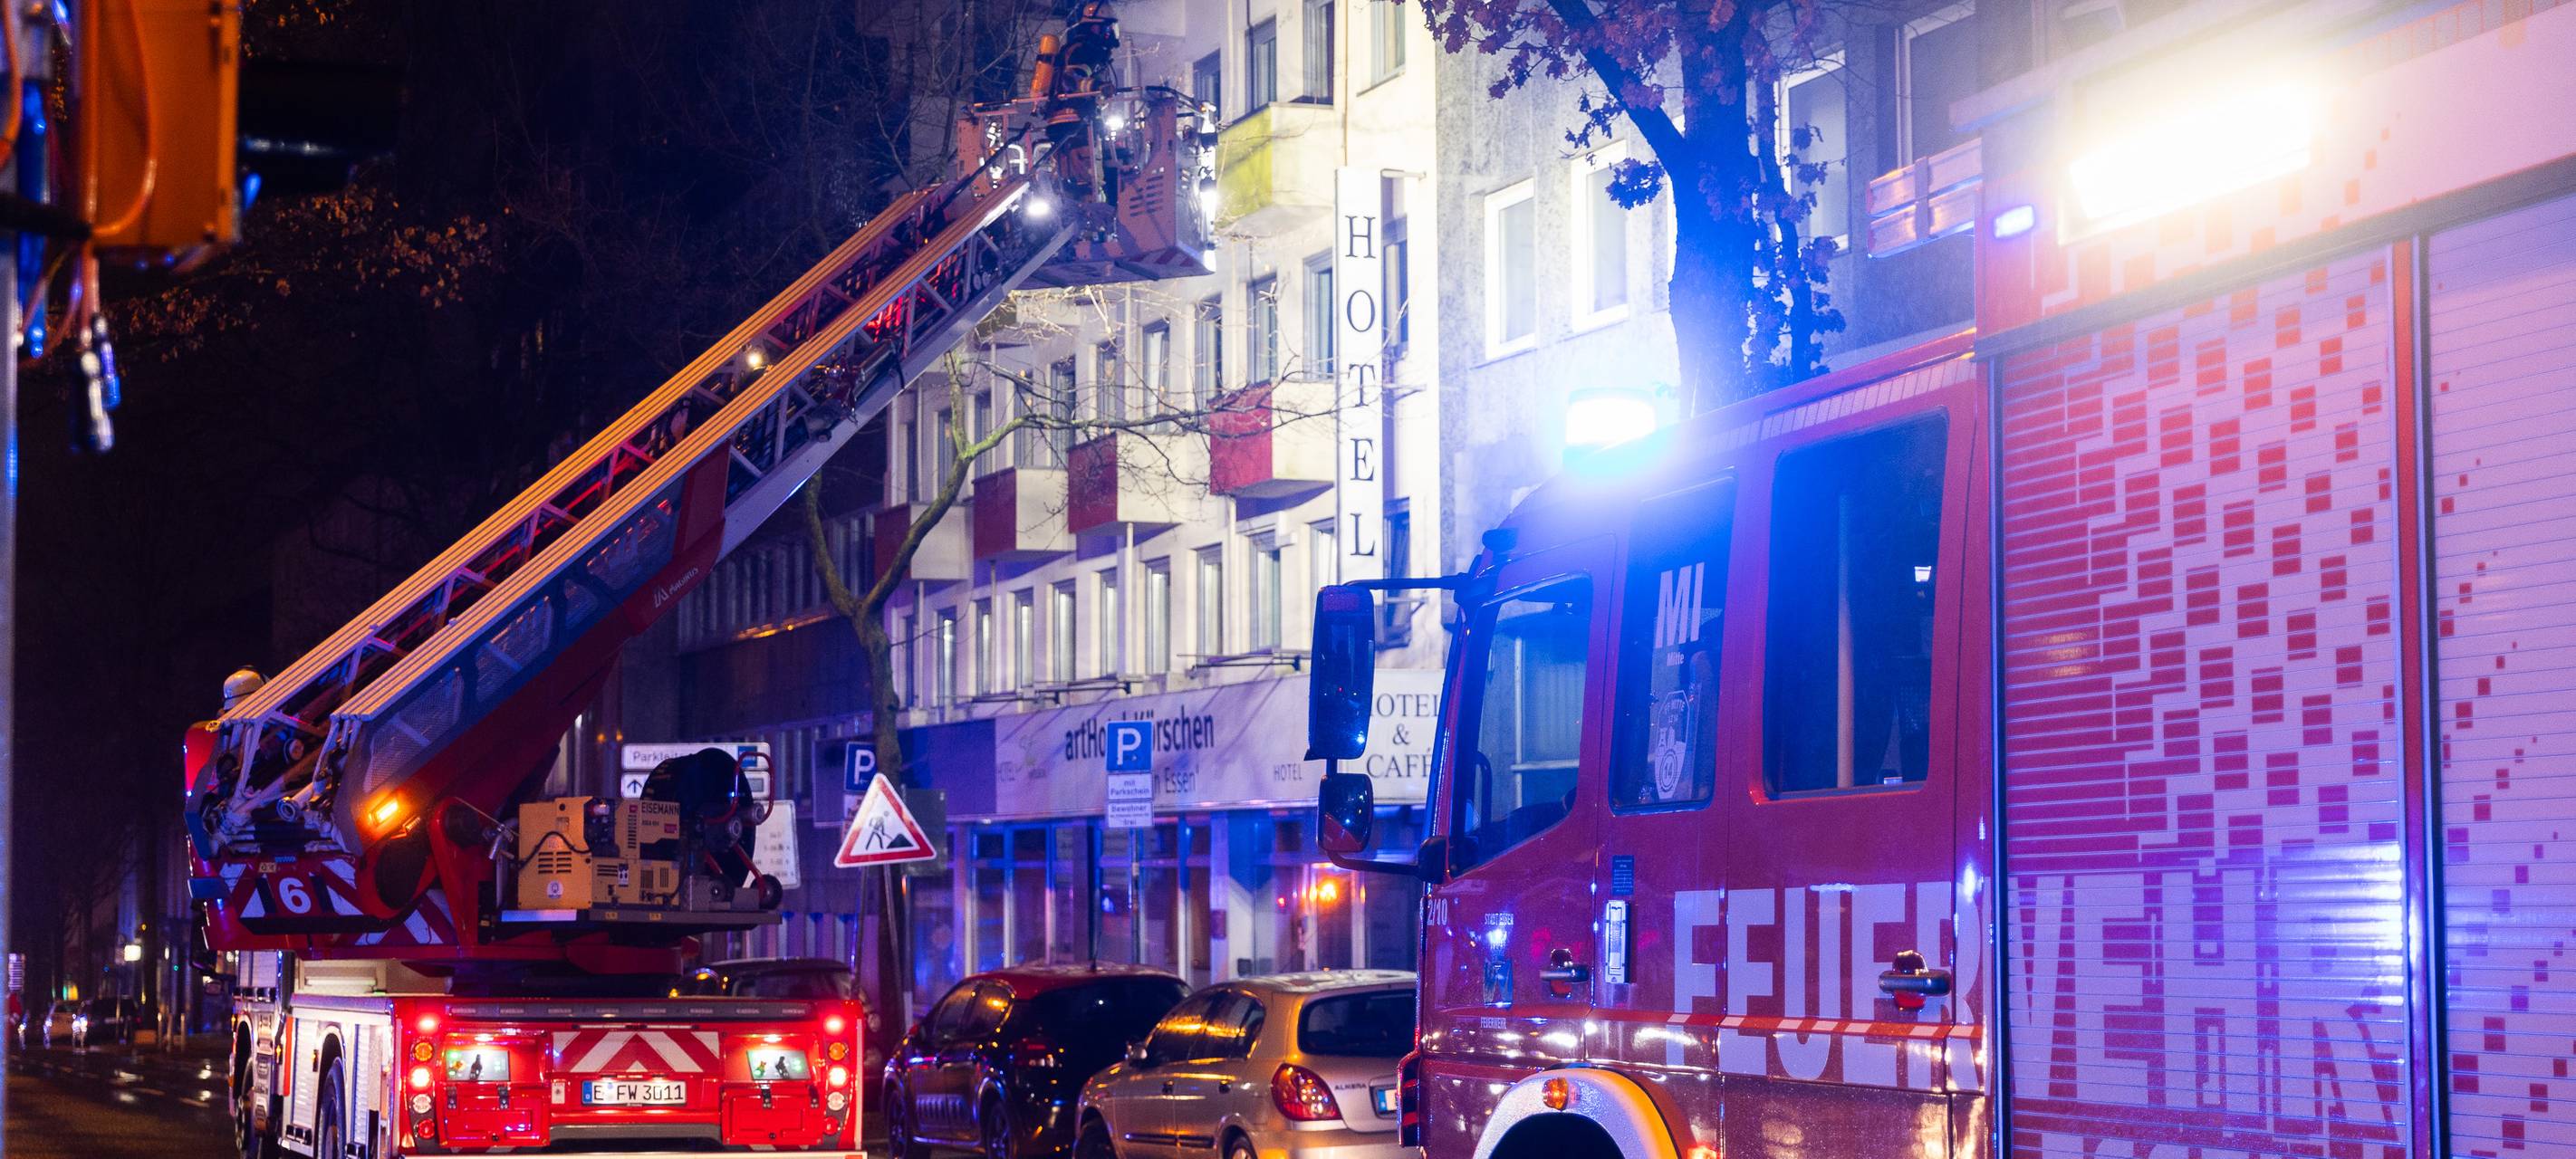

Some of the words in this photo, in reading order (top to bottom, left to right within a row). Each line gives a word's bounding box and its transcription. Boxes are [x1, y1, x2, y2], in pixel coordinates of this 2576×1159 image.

[1345, 215, 1377, 557] HOTEL
[1653, 561, 1705, 649] MI
[1667, 651, 1685, 667] Mitte
[1370, 692, 1440, 719] OTEL
[1393, 723, 1411, 746] &
[1117, 727, 1141, 766] P
[854, 749, 876, 785] P
[1274, 763, 1302, 781] HOTEL
[1110, 788, 1150, 796] Parkschein
[641, 801, 679, 815] EISEMANN
[1111, 804, 1148, 812] Bewohner
[279, 876, 312, 914] 6
[1666, 867, 2404, 1143] FEUERWEHR
[593, 1085, 604, 1101] E
[617, 1085, 638, 1101] FW
[643, 1085, 684, 1101] 3011
[1334, 1083, 1367, 1091] ALMERA
